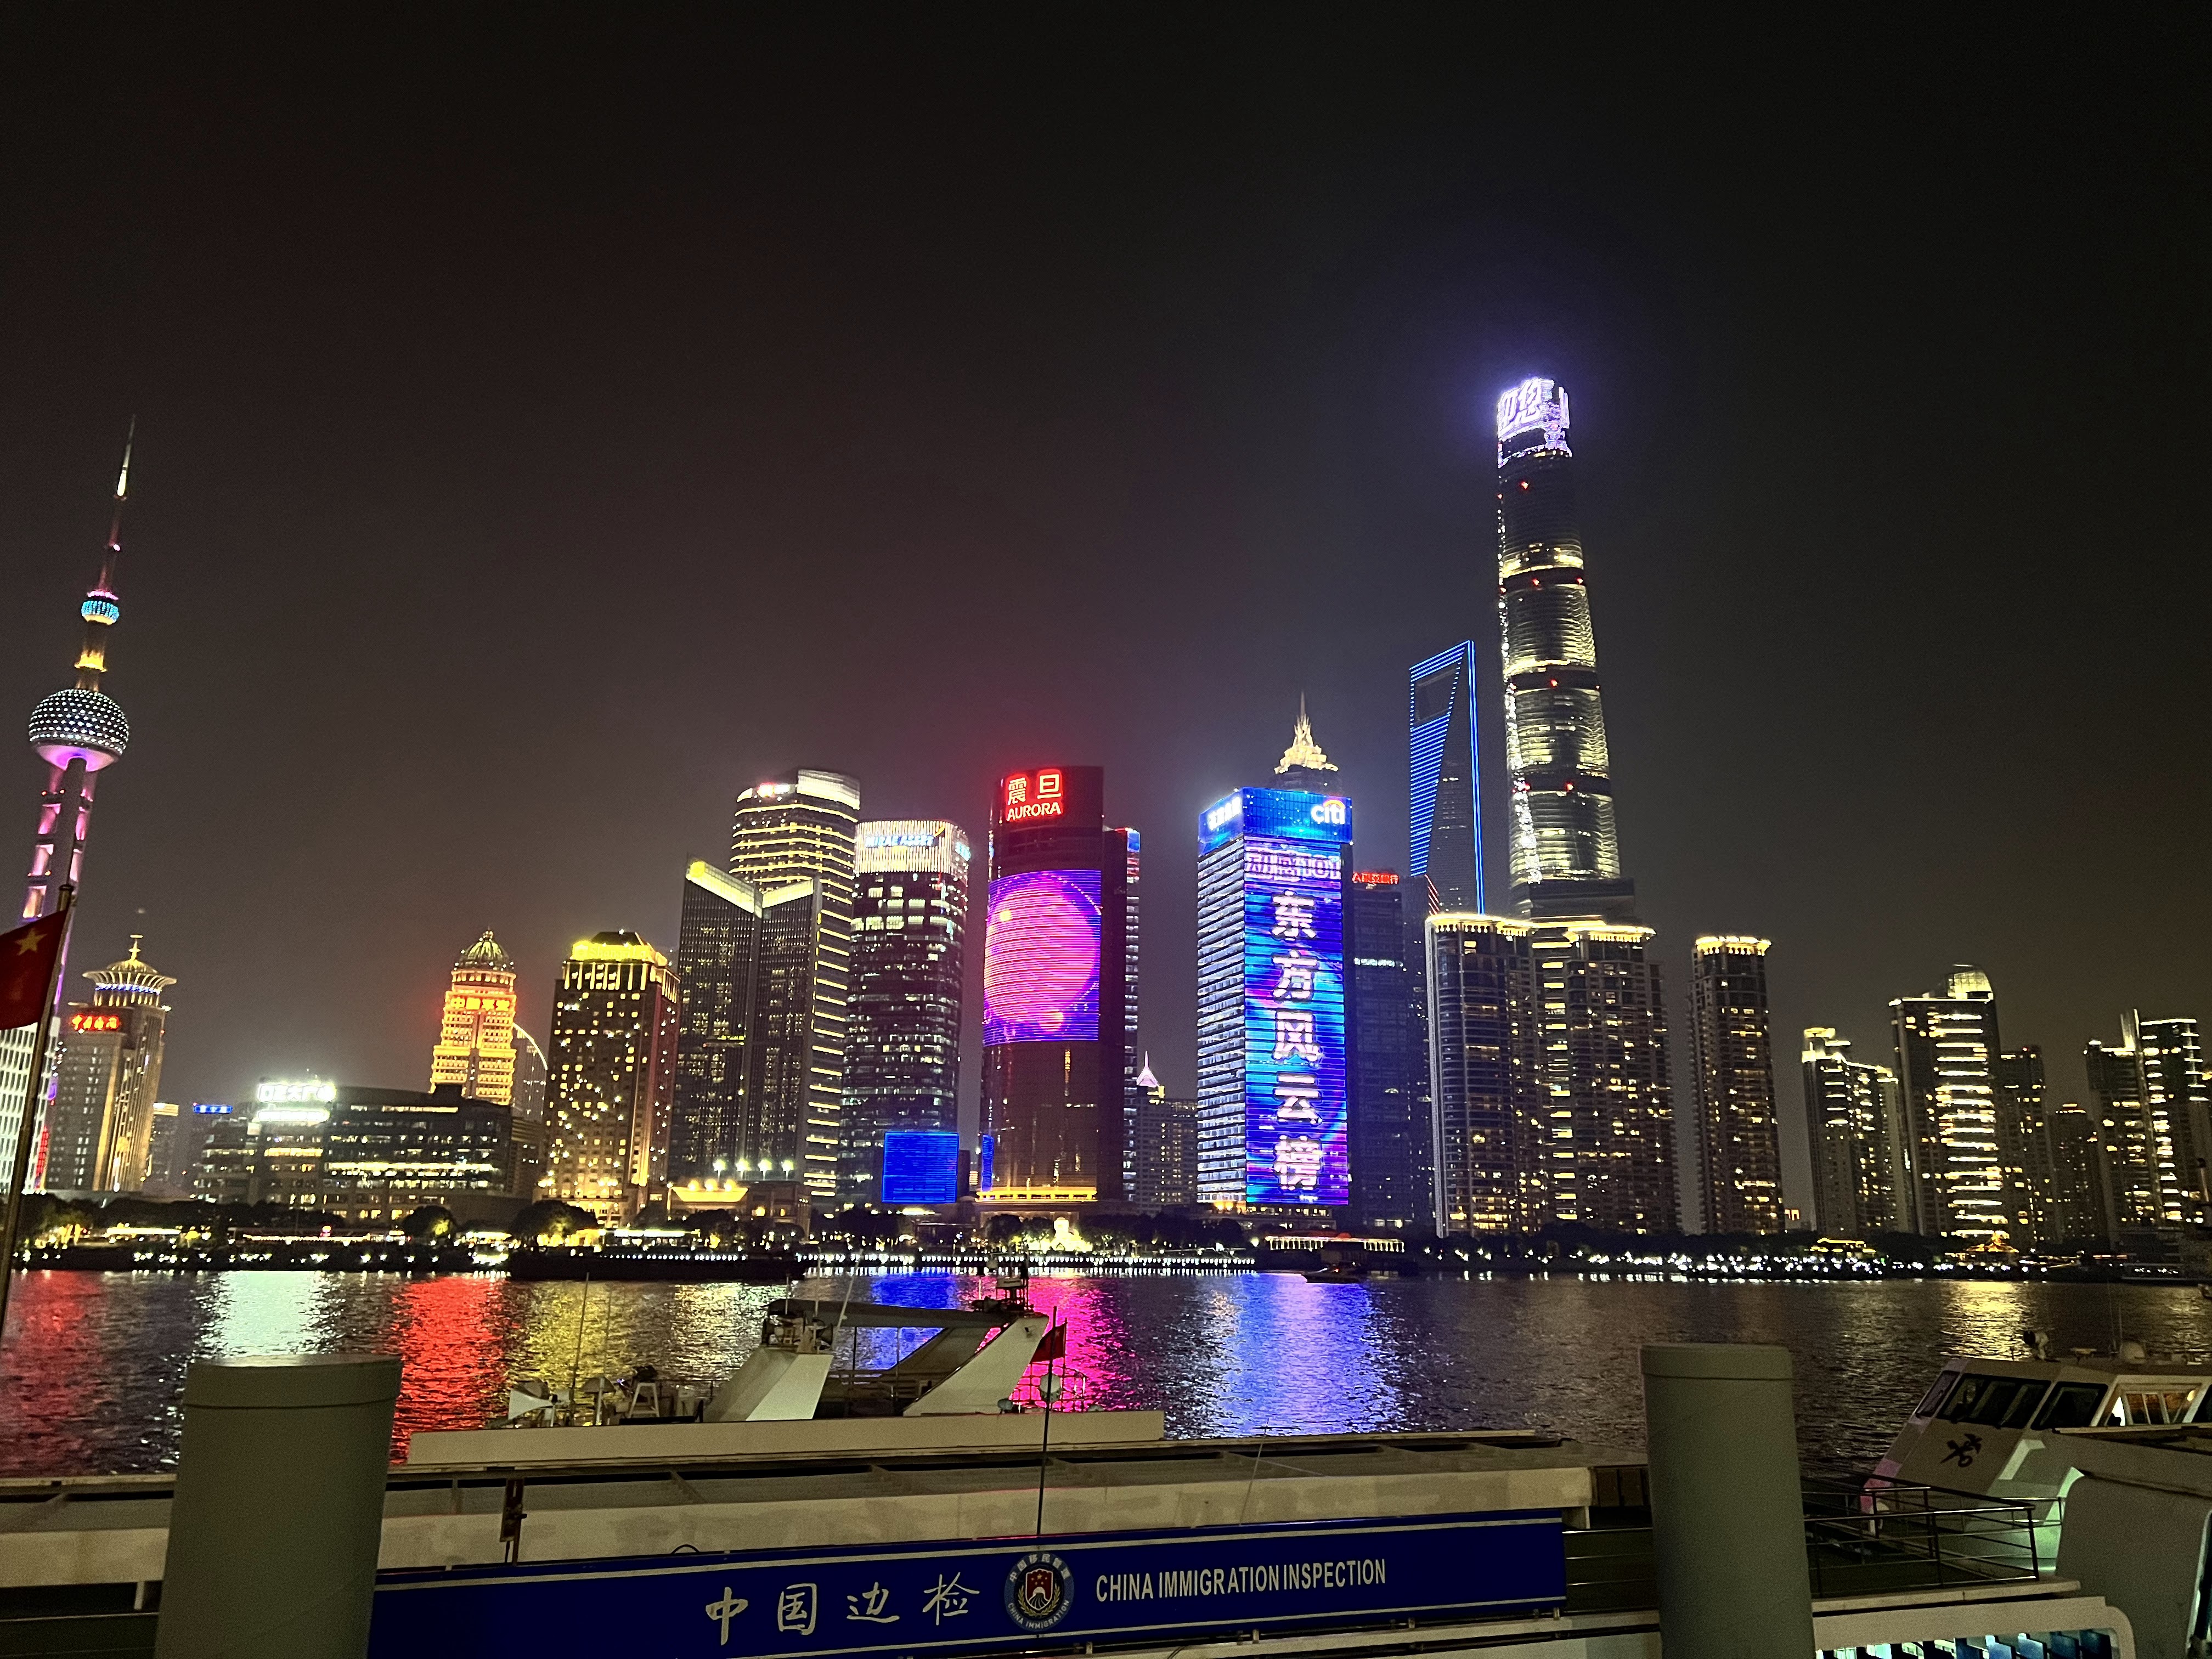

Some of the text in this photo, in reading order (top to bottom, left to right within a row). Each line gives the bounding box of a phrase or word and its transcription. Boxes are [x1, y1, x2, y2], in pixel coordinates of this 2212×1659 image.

[1007, 774, 1062, 806] 震旦
[1006, 802, 1062, 822] AURORA
[589, 946, 647, 960] ShangriLa
[1097, 1558, 1386, 1602] CHINA IMMIGRATION INSPECTION
[705, 1572, 980, 1646] 中国边检
[1007, 1599, 1070, 1630] CHINA IMMIGRATION
